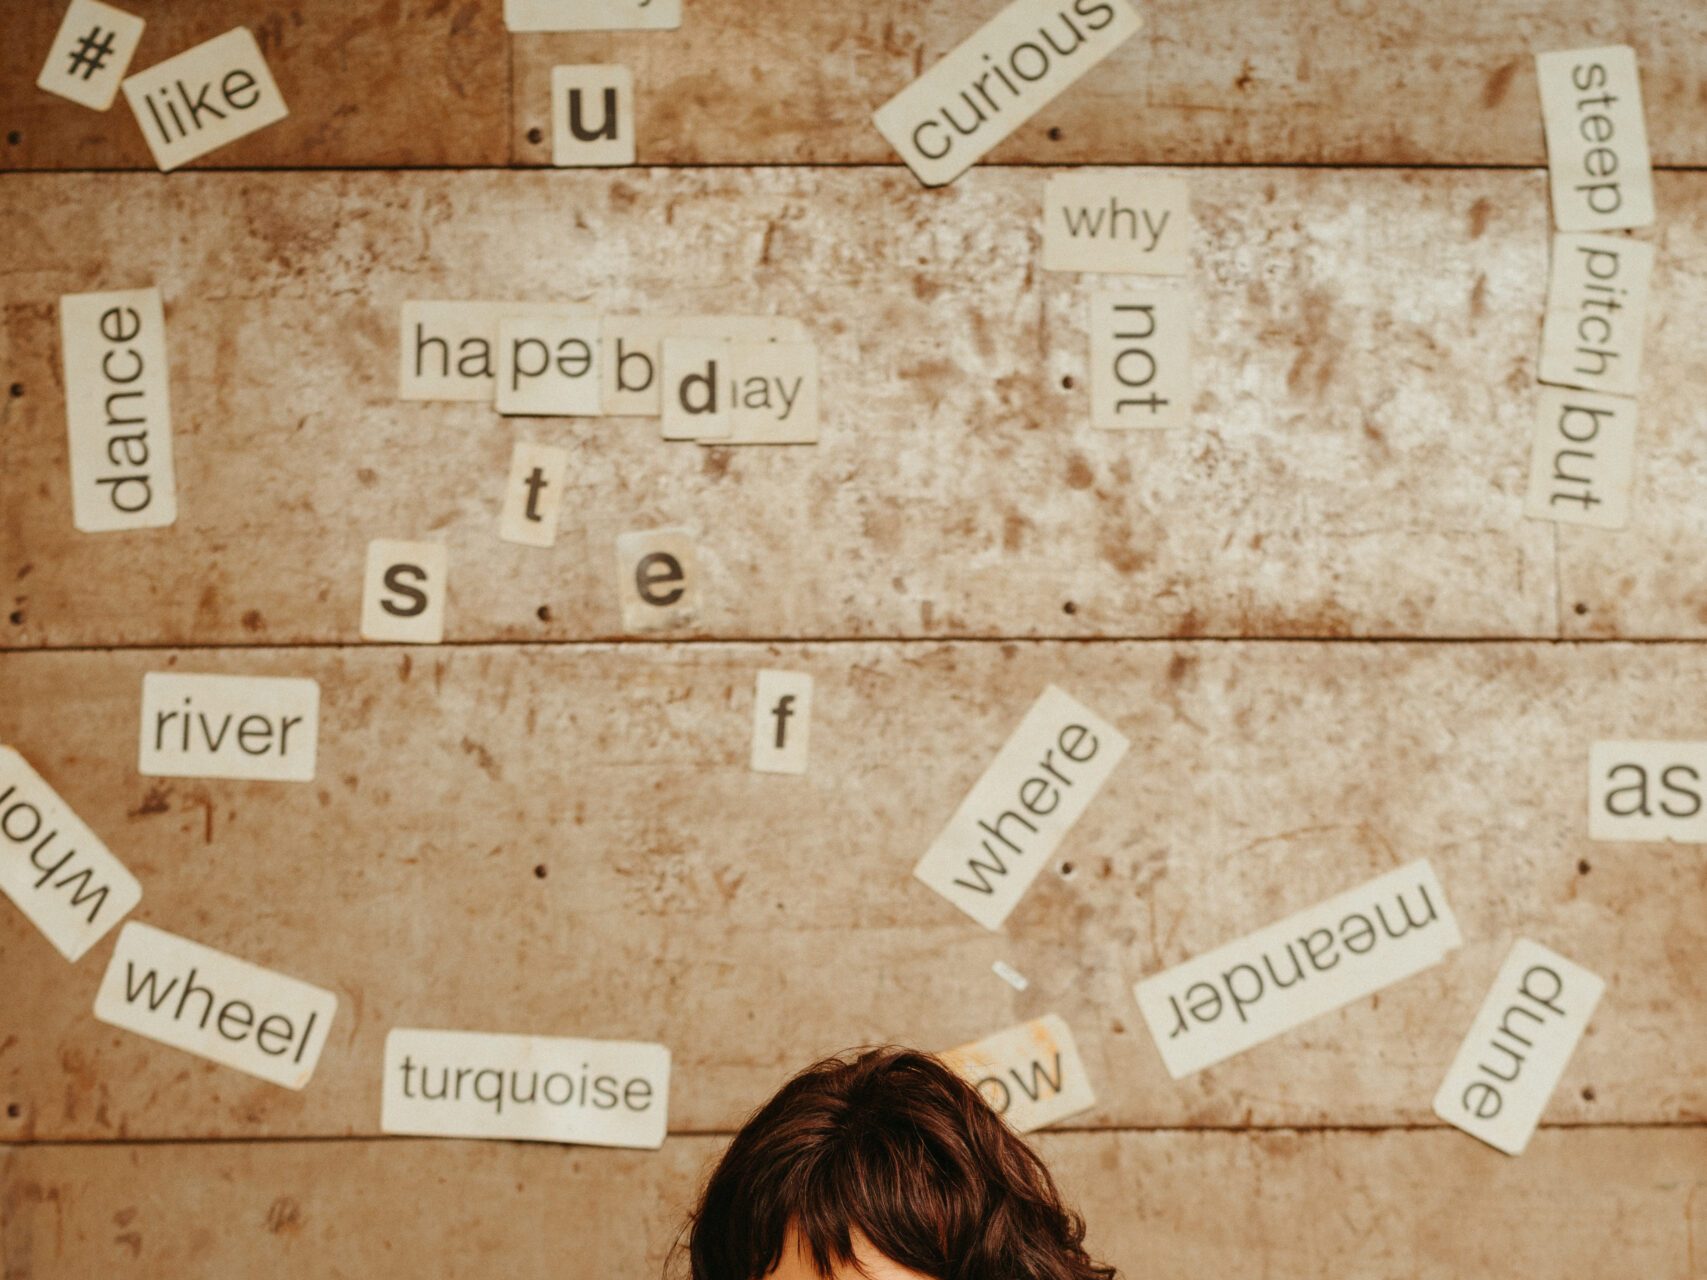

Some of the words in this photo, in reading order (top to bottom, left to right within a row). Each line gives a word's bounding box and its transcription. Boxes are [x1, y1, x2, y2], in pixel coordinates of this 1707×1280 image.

[68, 27, 115, 80] #
[912, 0, 1114, 160] curious
[145, 67, 261, 145] like
[569, 88, 617, 142] u
[1572, 63, 1621, 214] steep
[1063, 197, 1170, 252] why
[1113, 305, 1168, 413] not
[1573, 245, 1626, 385] pitch
[96, 307, 151, 513] dance
[525, 467, 548, 522] t
[1550, 405, 1614, 509] but
[381, 564, 427, 617] s
[636, 552, 684, 606] e
[156, 698, 302, 756] river
[772, 695, 795, 748] f
[953, 721, 1100, 897] where
[1605, 764, 1702, 818] as
[0, 785, 110, 925] who
[1167, 883, 1440, 1041] meander
[124, 959, 319, 1064] wheel
[1461, 963, 1565, 1121] dune
[400, 1056, 652, 1114] turquoise
